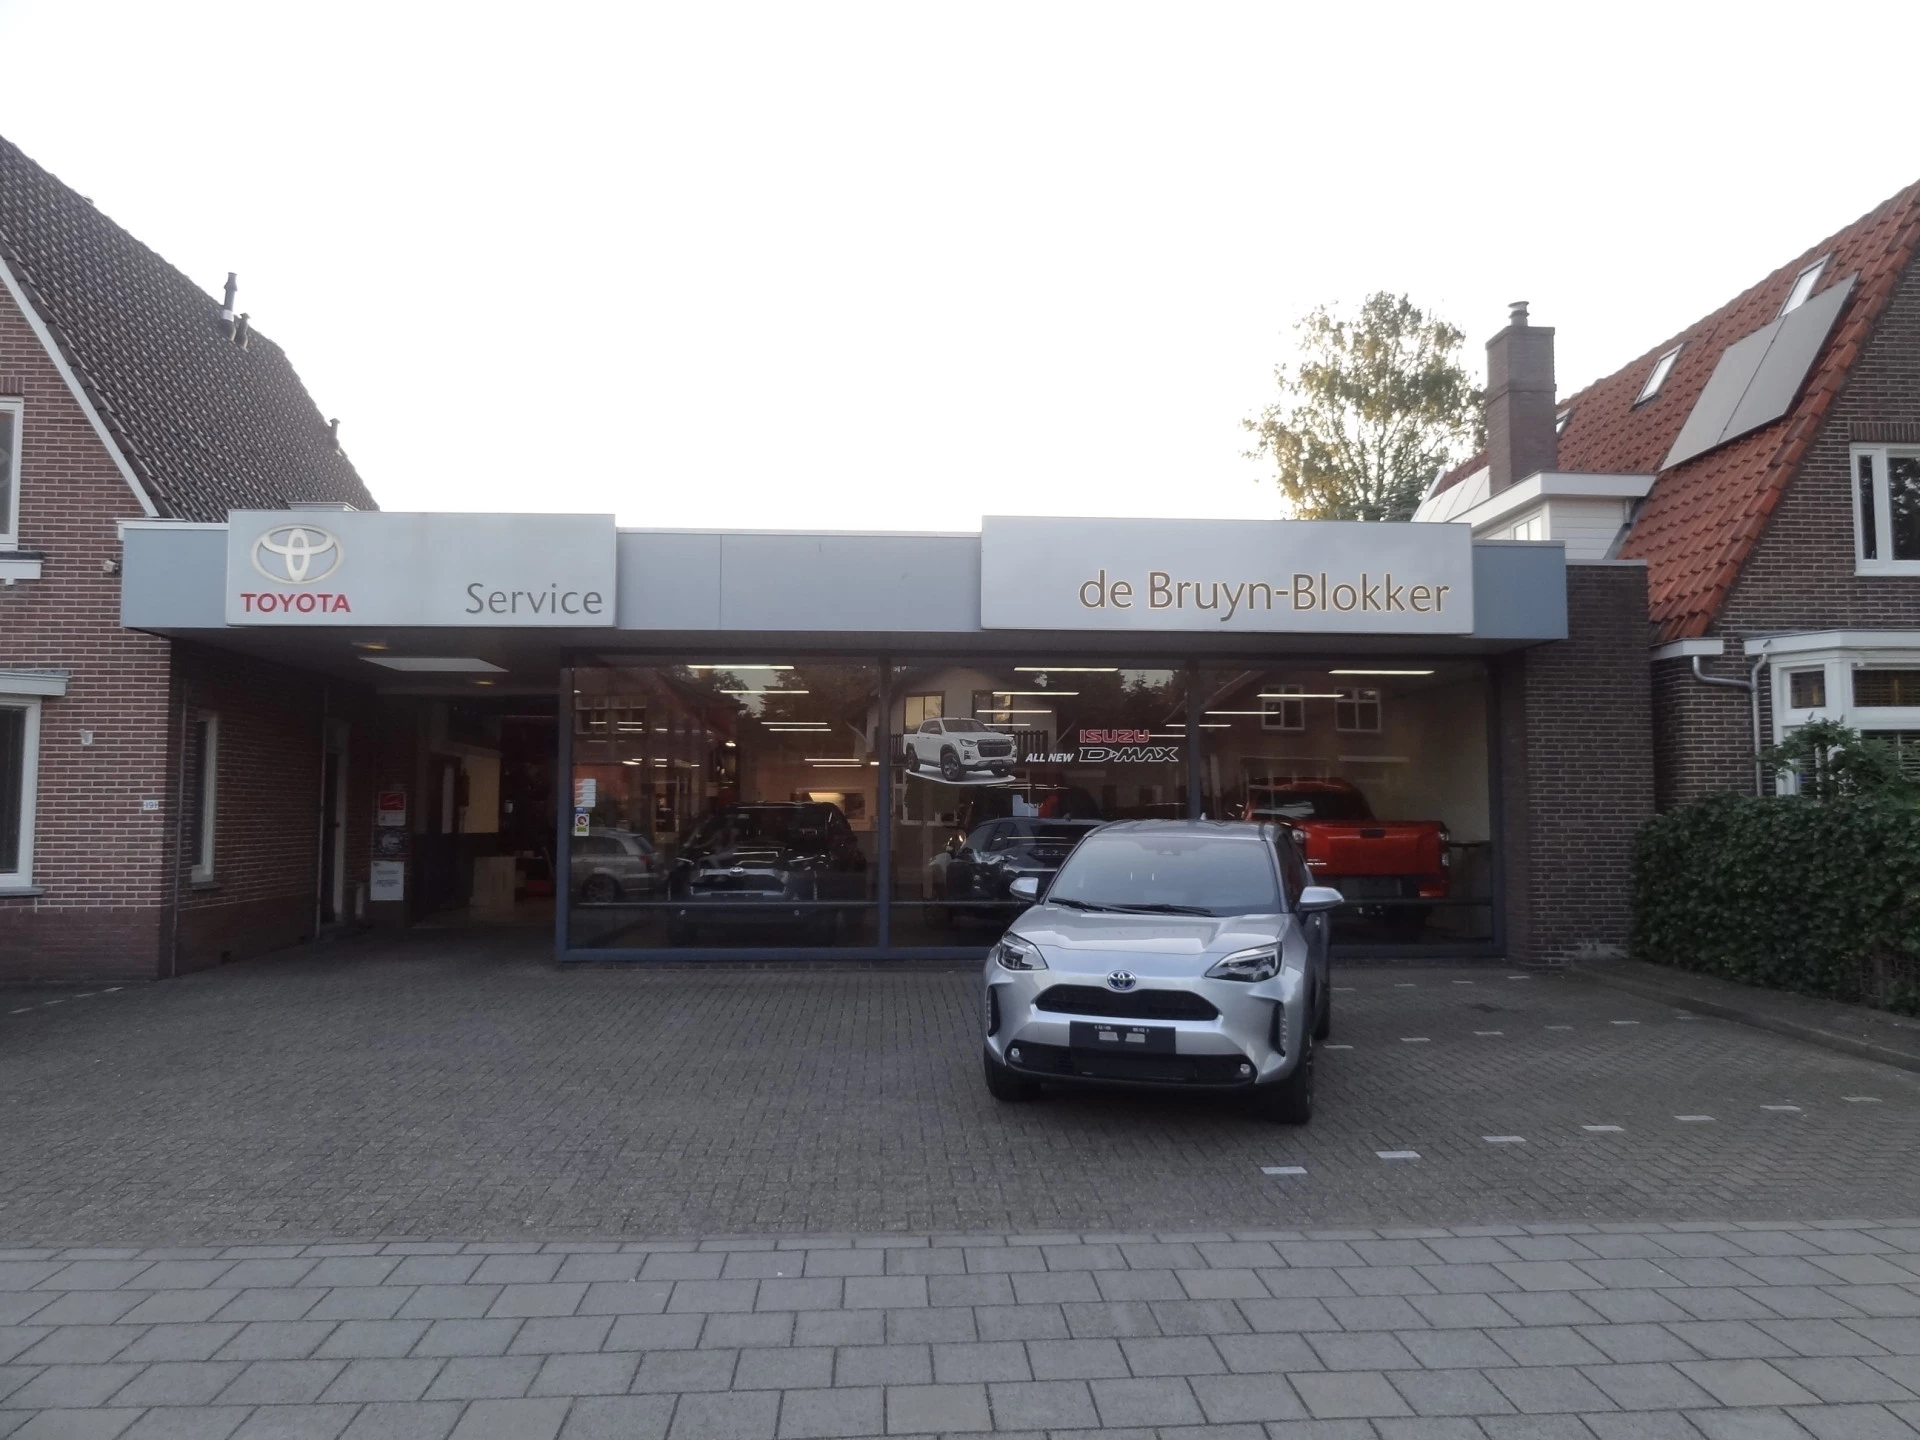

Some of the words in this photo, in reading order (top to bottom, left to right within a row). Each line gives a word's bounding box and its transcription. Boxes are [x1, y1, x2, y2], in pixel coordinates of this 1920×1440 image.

[240, 592, 352, 613] TOYOTA
[465, 582, 603, 614] Service
[1079, 569, 1133, 609] de
[1148, 571, 1450, 622] Bruyn-Blokker
[1079, 729, 1150, 743] ISUZU
[1025, 753, 1046, 762] ALL
[1047, 753, 1074, 762] NEW
